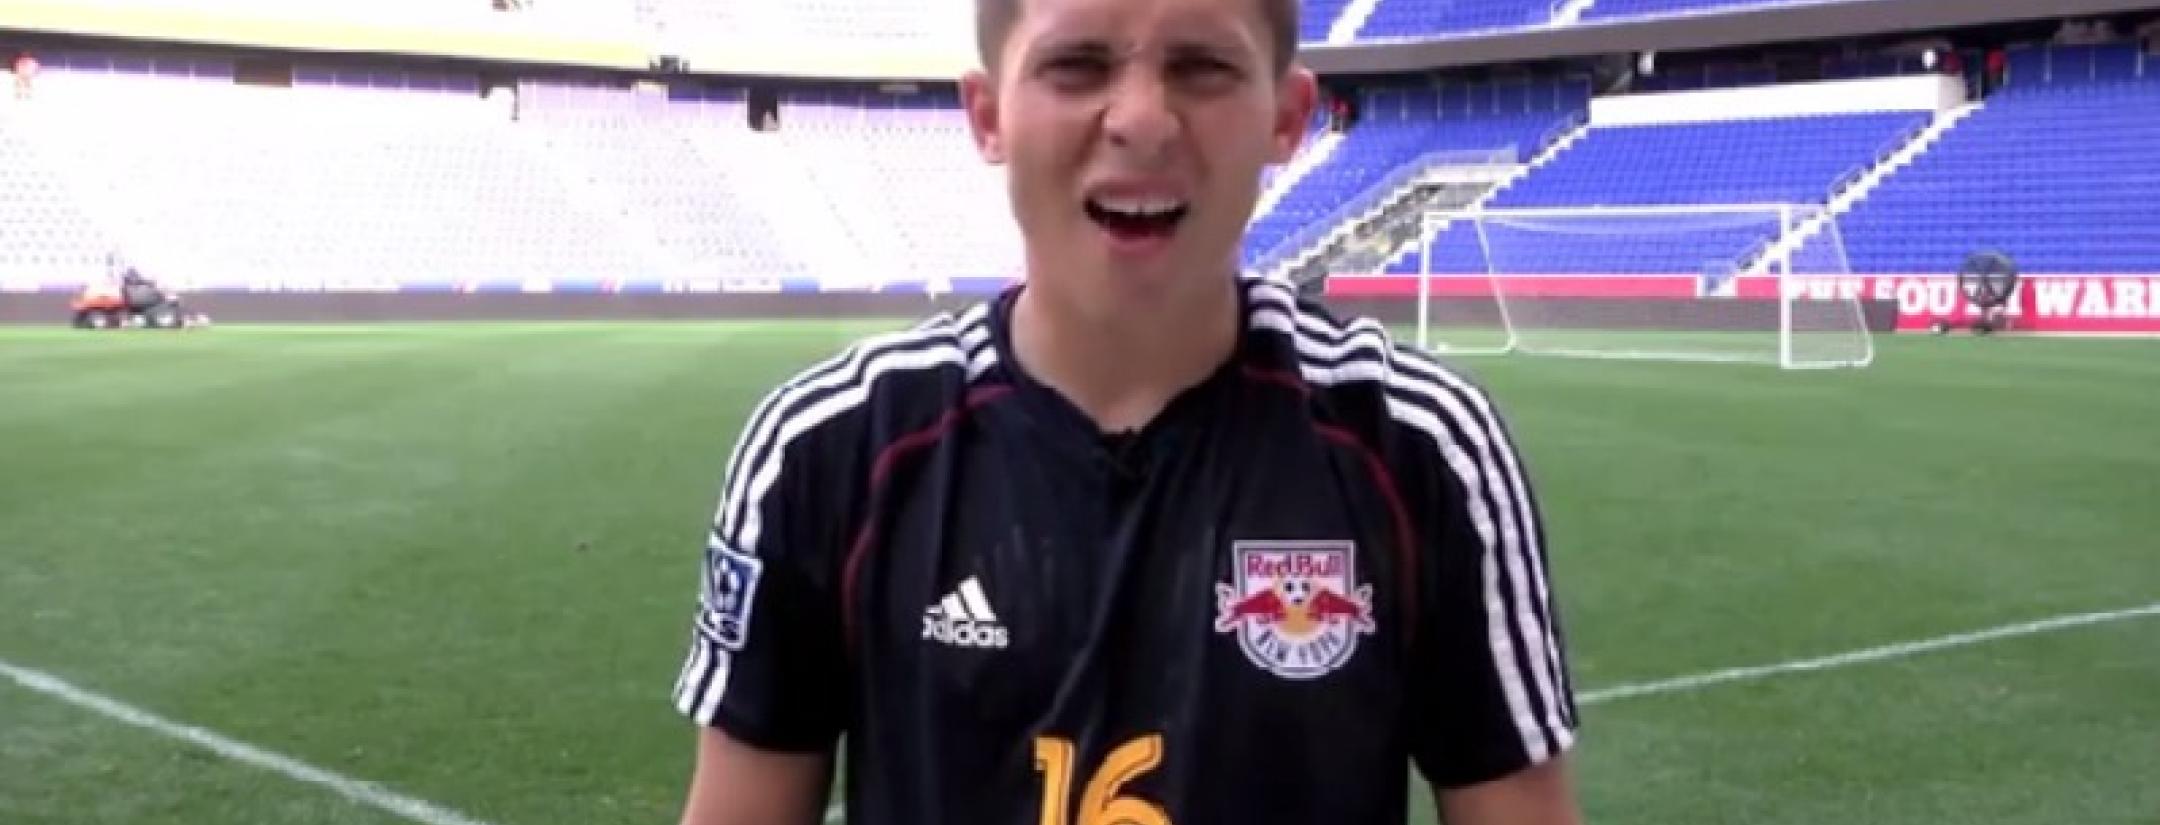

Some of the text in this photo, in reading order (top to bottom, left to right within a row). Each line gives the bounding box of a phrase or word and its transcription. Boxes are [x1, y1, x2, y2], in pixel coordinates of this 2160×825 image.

[2034, 279, 2160, 318] WAR
[1247, 553, 1343, 578] Red Bull
